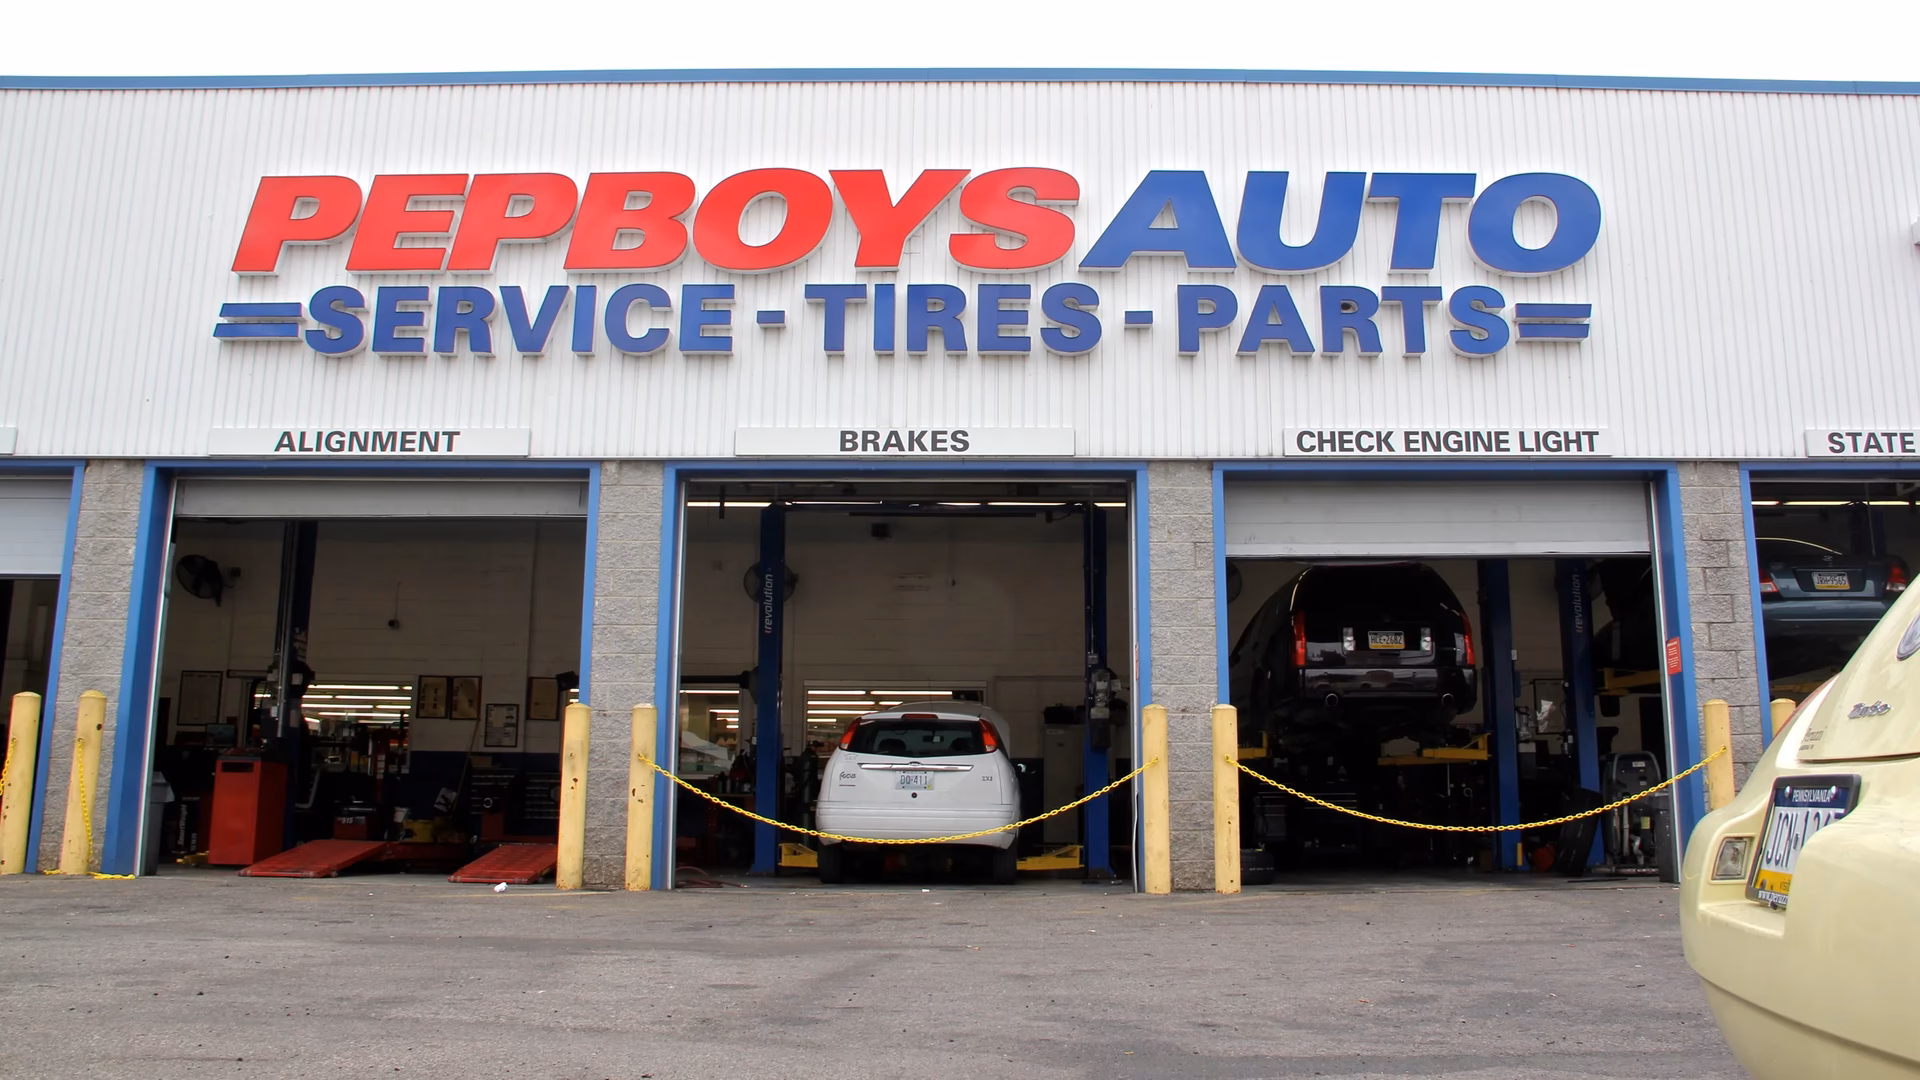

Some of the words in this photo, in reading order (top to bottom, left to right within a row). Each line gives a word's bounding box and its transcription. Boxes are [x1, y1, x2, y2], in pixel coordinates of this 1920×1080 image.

[1078, 169, 1601, 277] AUTO
[304, 283, 736, 356] SERVICE
[803, 282, 1103, 355] TIRES
[1176, 284, 1511, 358] PARTS
[273, 430, 462, 453] ALIGNMENT
[839, 429, 971, 452] BRAKES
[1296, 430, 1396, 453] CHECK
[1402, 430, 1511, 453] ENGINE
[1517, 430, 1600, 453] LIGHT
[1827, 431, 1917, 454] STATE
[1791, 788, 1831, 803] PENNSYLVANIA
